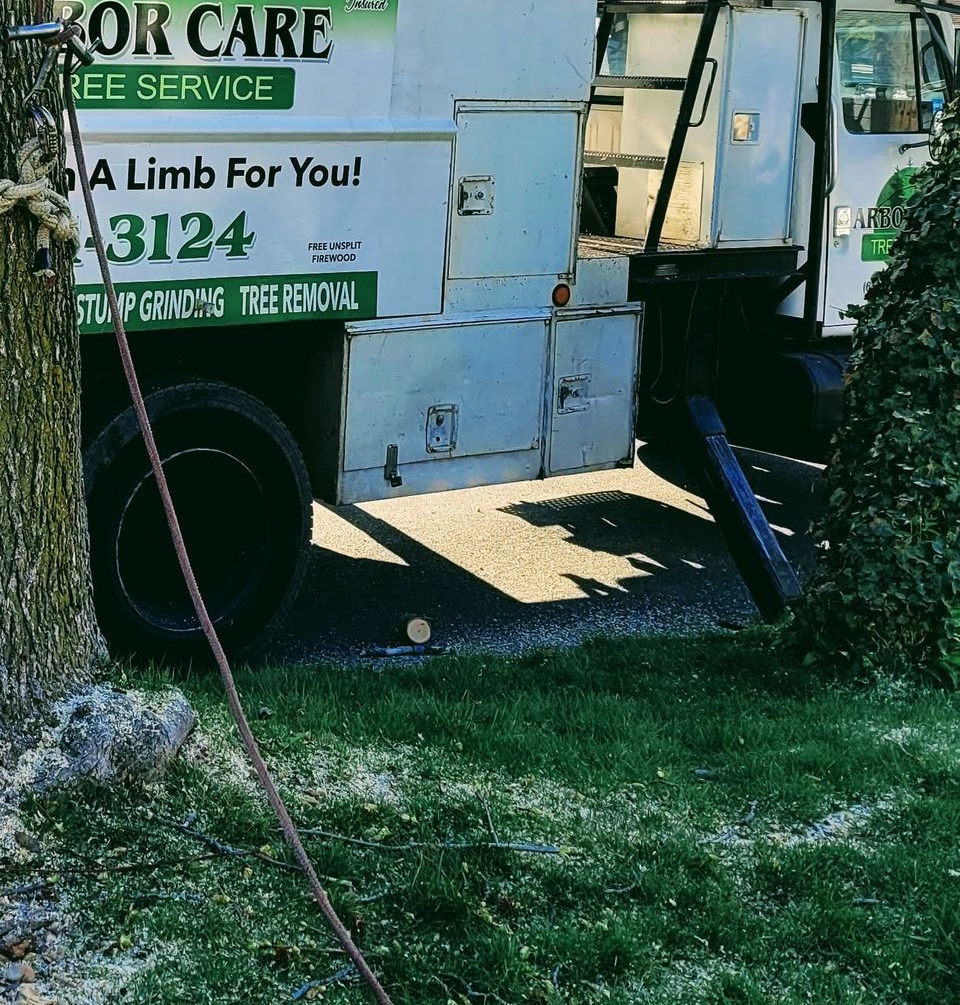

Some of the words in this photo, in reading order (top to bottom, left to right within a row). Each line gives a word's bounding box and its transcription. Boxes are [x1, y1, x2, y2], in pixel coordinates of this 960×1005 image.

[187, 4, 333, 60] CARE
[137, 74, 274, 101] SERVICE
[90, 158, 116, 191] A
[127, 156, 216, 191] Limb
[227, 157, 282, 188] For
[289, 156, 362, 187] You!
[308, 243, 328, 251] FREE
[329, 241, 362, 250] UNSPLIT
[311, 253, 356, 263] FIREWOOD
[77, 291, 136, 326] STUMP
[139, 286, 224, 322] GRINDING
[240, 284, 279, 316] TREE
[282, 281, 359, 314] REMOVAL
